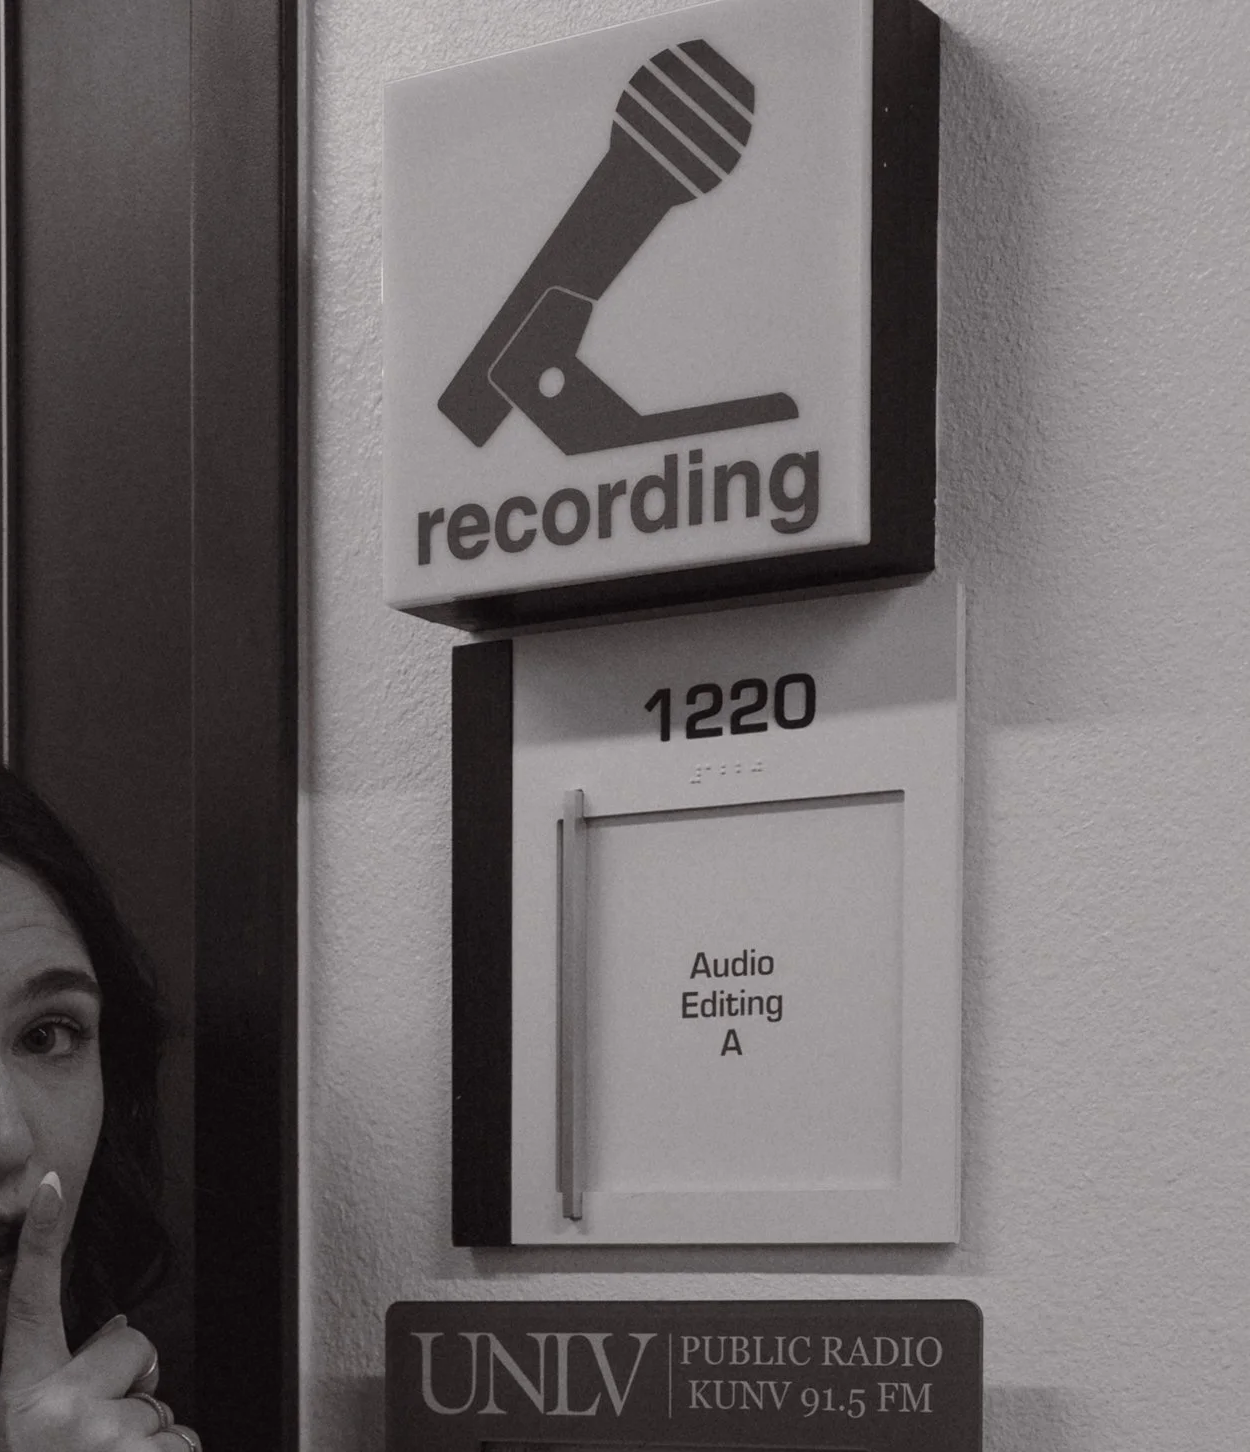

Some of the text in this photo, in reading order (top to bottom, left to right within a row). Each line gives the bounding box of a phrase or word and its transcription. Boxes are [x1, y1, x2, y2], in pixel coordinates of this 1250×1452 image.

[417, 448, 819, 565] recording
[644, 673, 817, 742] 1220
[690, 949, 774, 979] Audio
[682, 989, 783, 1023] Editing
[720, 1029, 743, 1056] A
[680, 1336, 943, 1367] PUBLIC RADIO
[410, 1332, 658, 1417] UNLV
[689, 1380, 933, 1418] KUNV 91.5 FM
